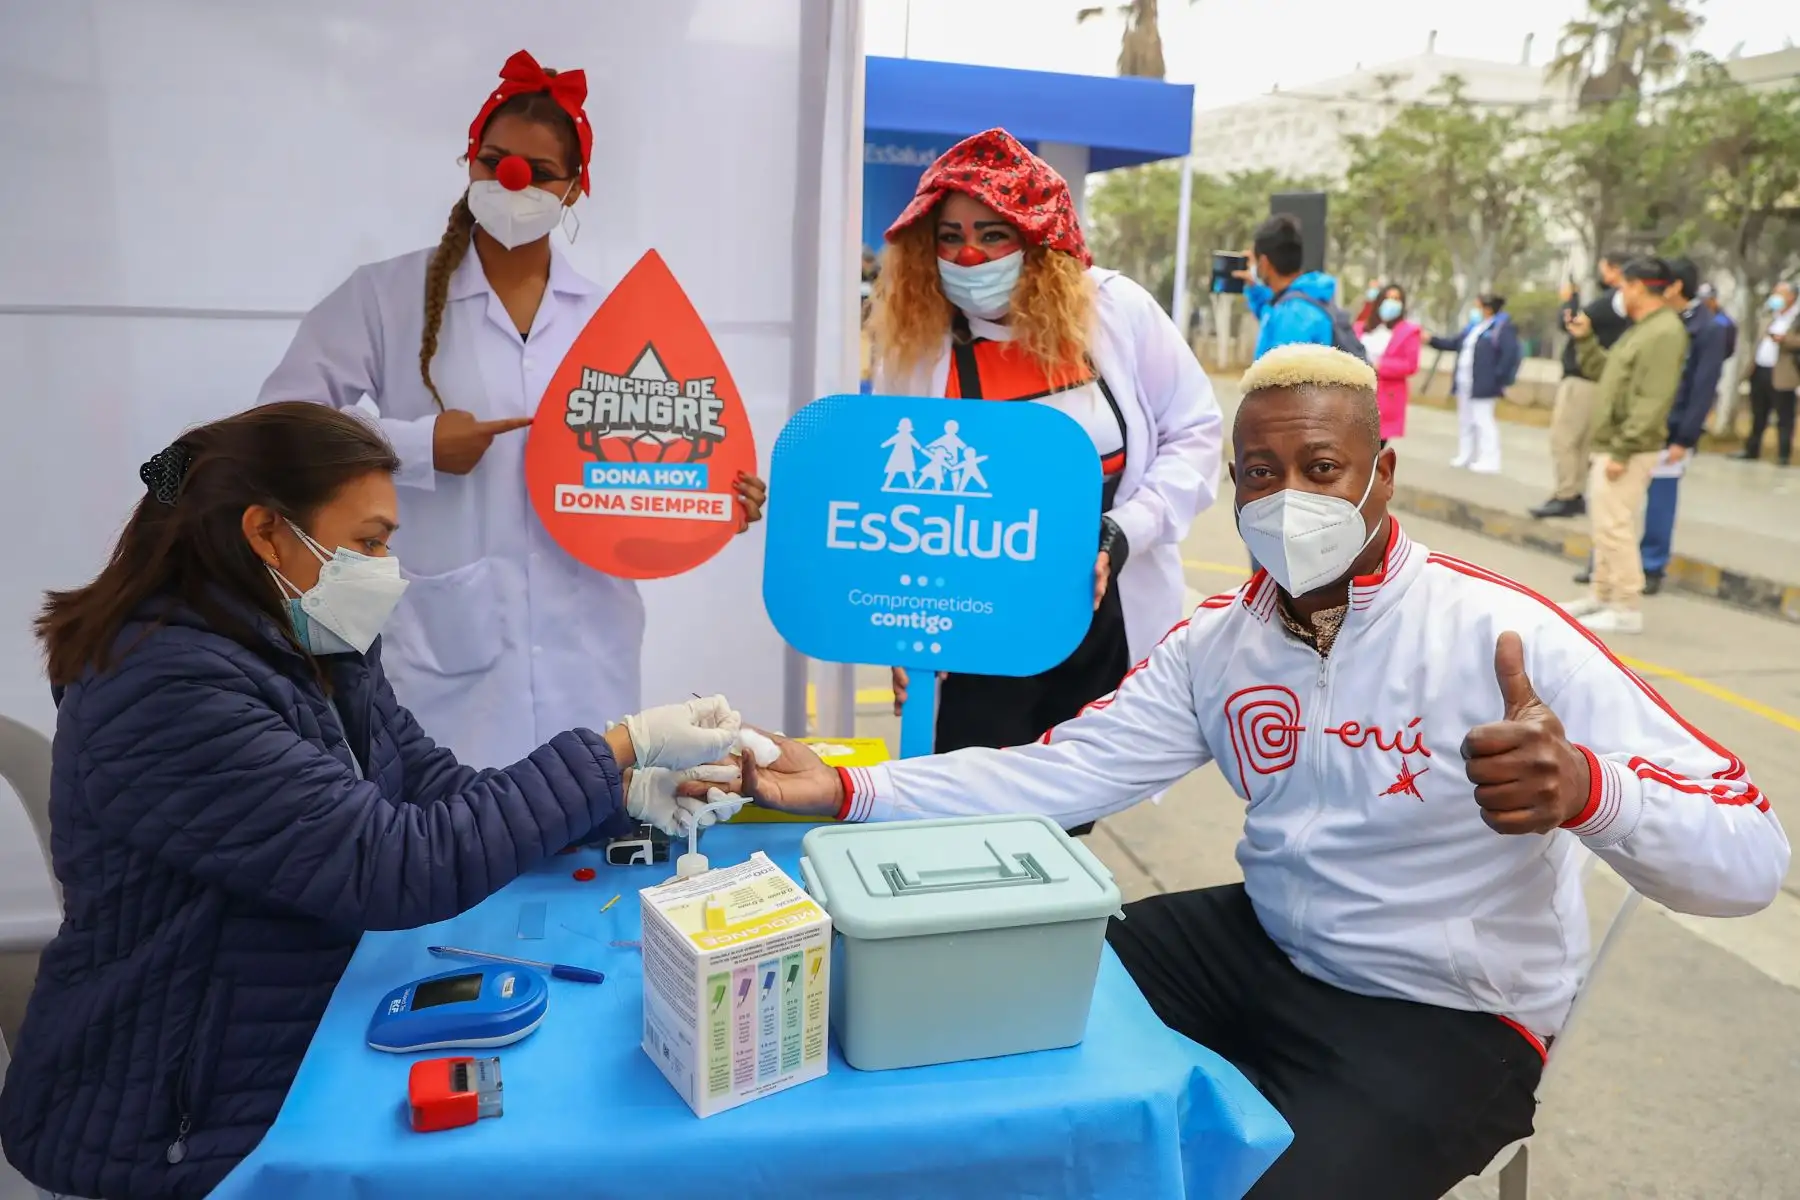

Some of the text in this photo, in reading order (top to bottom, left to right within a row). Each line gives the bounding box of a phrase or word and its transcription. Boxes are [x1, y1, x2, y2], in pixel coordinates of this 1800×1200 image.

[583, 368, 715, 399] HINCHAS DE
[566, 390, 726, 437] SANGRE
[591, 469, 702, 487] DONA HOY,
[561, 493, 724, 515] DONA SIEMPRE
[826, 500, 1039, 561] EsSalud
[848, 588, 993, 614] Comprometidos
[870, 610, 952, 634] contigo
